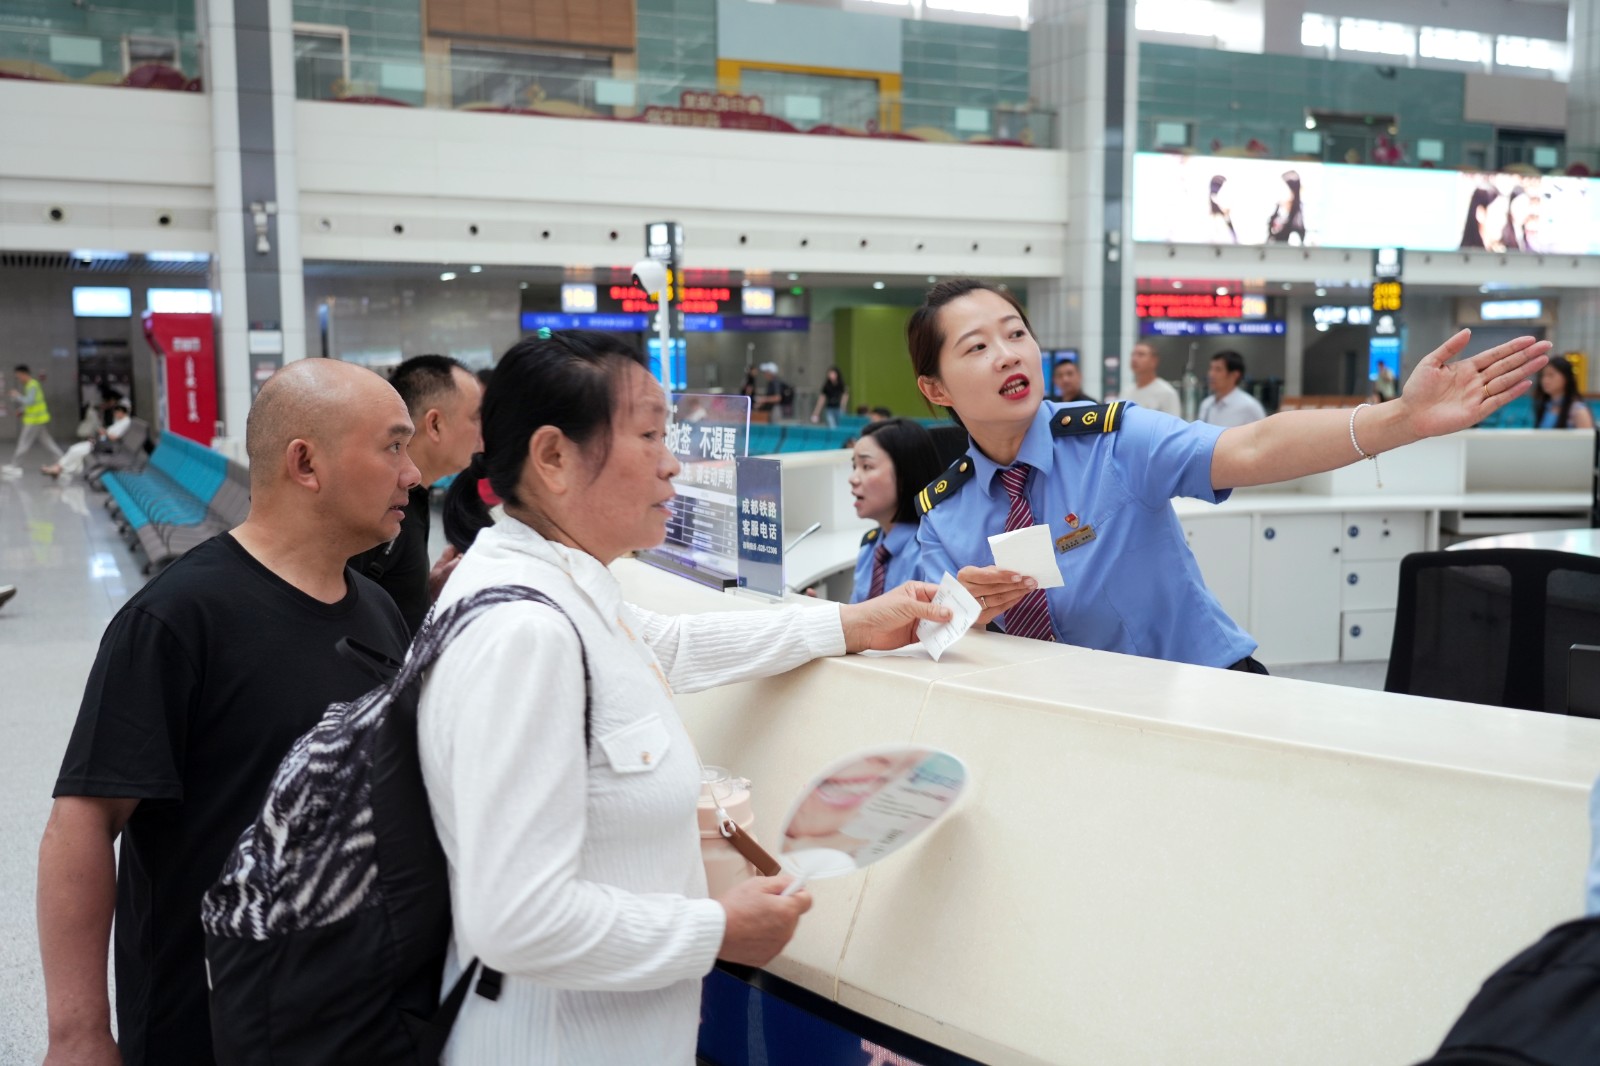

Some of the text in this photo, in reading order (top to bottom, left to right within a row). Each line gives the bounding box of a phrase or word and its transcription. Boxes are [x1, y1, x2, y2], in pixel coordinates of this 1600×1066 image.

[665, 422, 736, 460] 改签 不退票
[742, 498, 776, 518] 成都铁路
[742, 519, 777, 540] 客服电话
